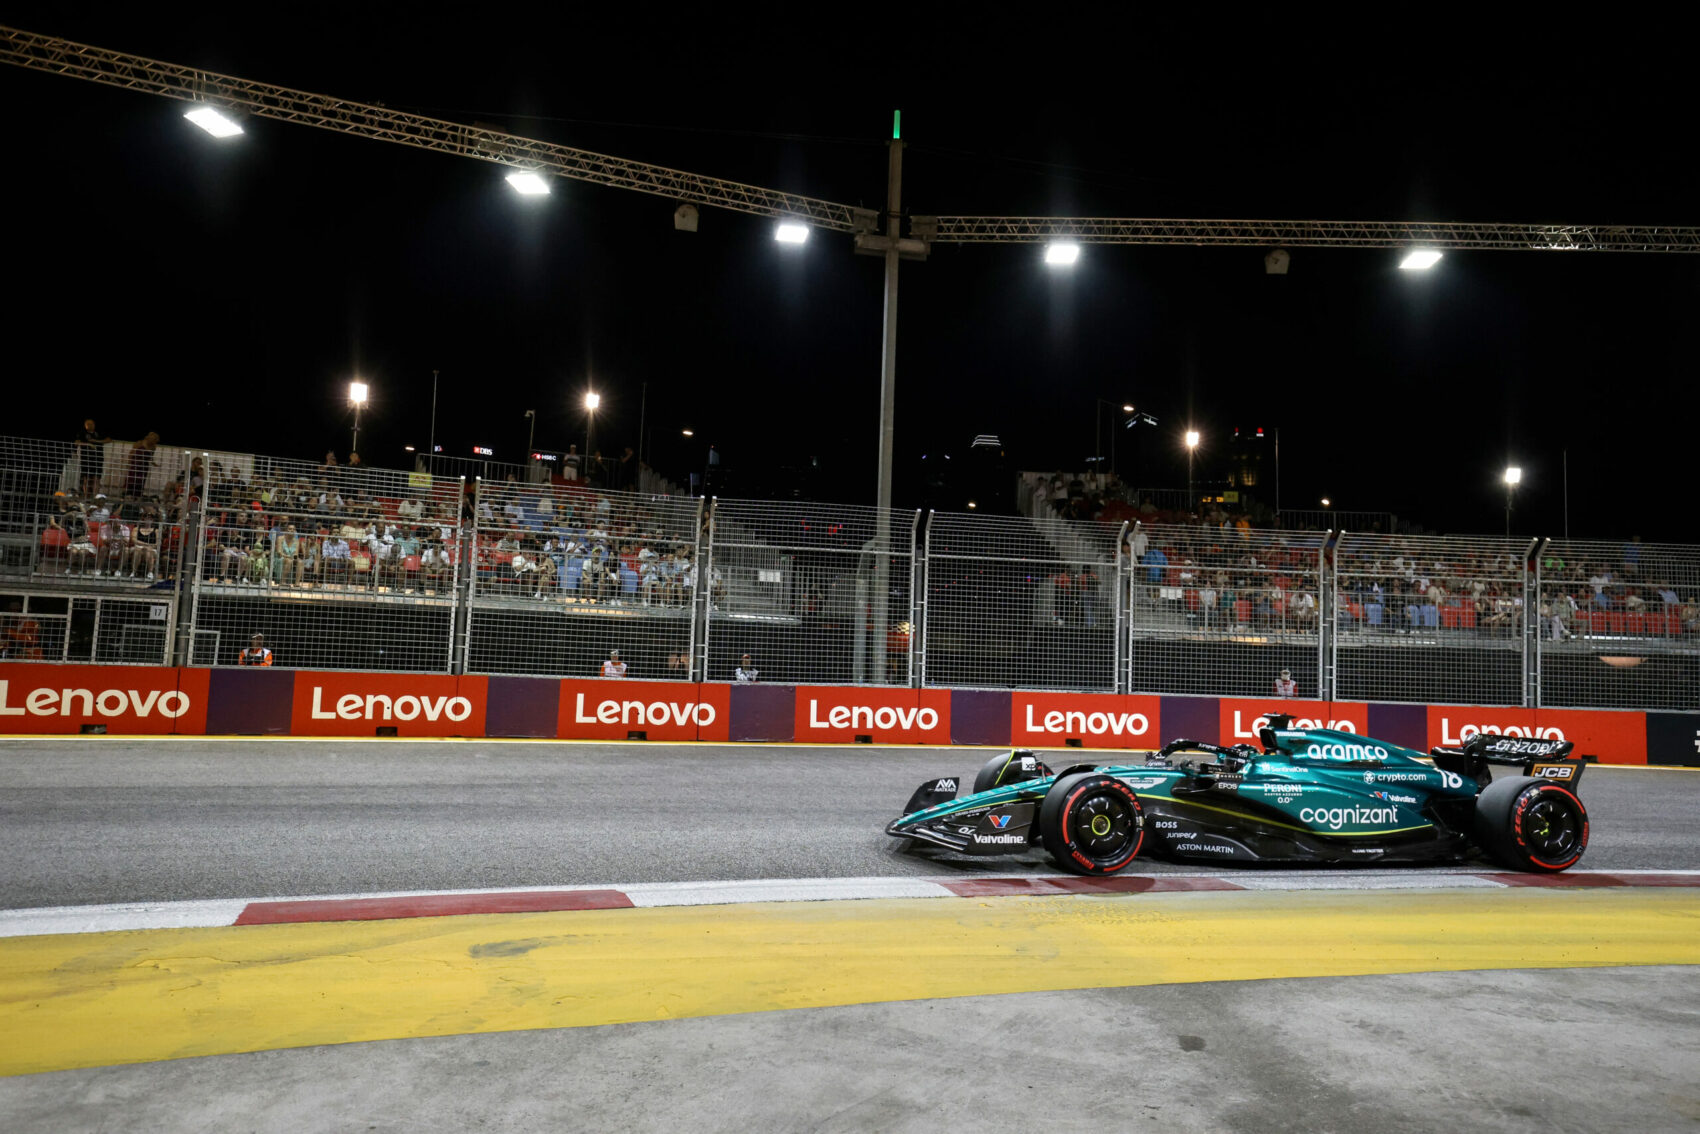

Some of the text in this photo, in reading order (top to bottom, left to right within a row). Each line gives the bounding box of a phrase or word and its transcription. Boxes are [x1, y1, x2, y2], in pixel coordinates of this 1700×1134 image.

[154, 608, 163, 617] 17
[0, 679, 190, 718] Lenovo
[311, 686, 472, 722] Lenovo
[575, 693, 716, 726] Lenovo
[809, 699, 939, 731] Lenovo
[1026, 704, 1149, 735] Lenovo
[1233, 710, 1357, 738] Leovo
[1307, 744, 1389, 760] aramco
[1377, 773, 1427, 782] crypto.com
[1534, 766, 1572, 778] JCB
[1218, 782, 1237, 790] EPOS
[1263, 783, 1303, 792] PERONI
[1155, 821, 1178, 829] BOSS
[1300, 804, 1399, 830] cognizant
[1176, 843, 1234, 854] ASTON MARTIN
